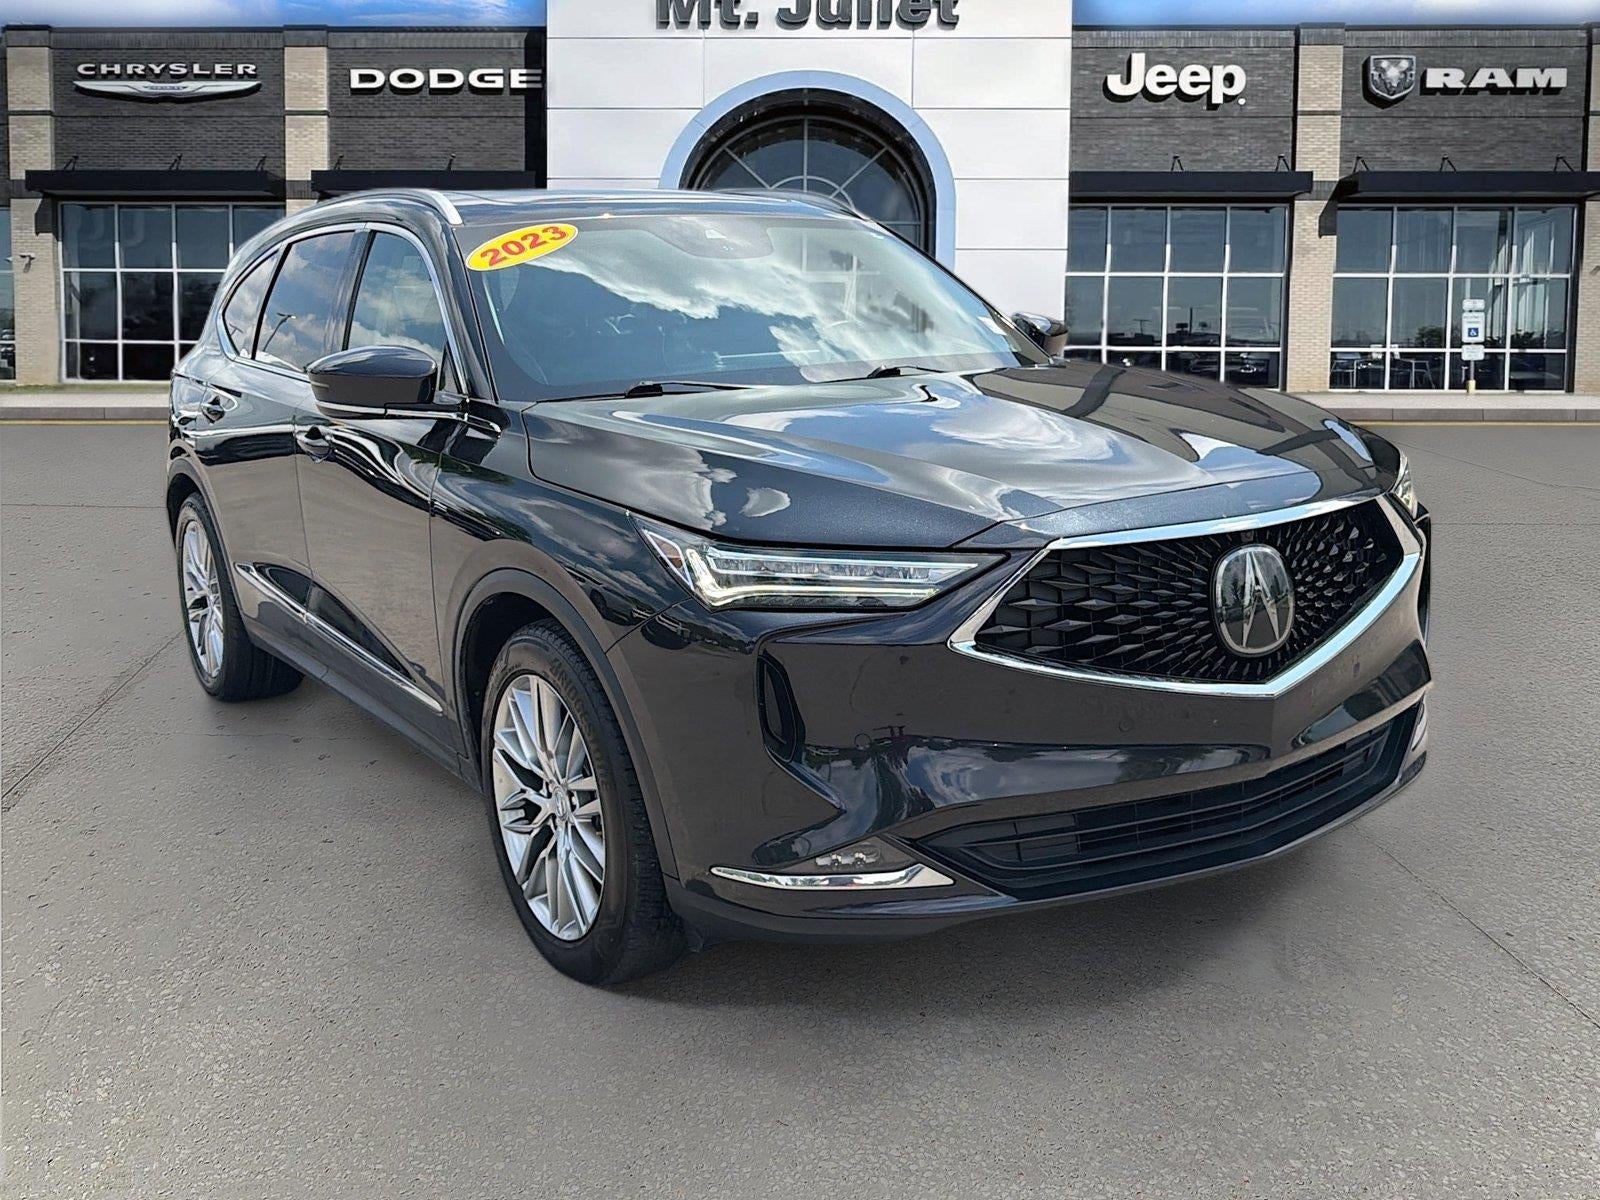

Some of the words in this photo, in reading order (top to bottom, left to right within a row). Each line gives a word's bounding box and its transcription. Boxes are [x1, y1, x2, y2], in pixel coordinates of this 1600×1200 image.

[656, 0, 759, 26] Mt.
[77, 63, 257, 75] CHRYSLER
[350, 68, 543, 89] DODGE
[1425, 67, 1568, 88] RAM
[480, 226, 567, 266] 2023
